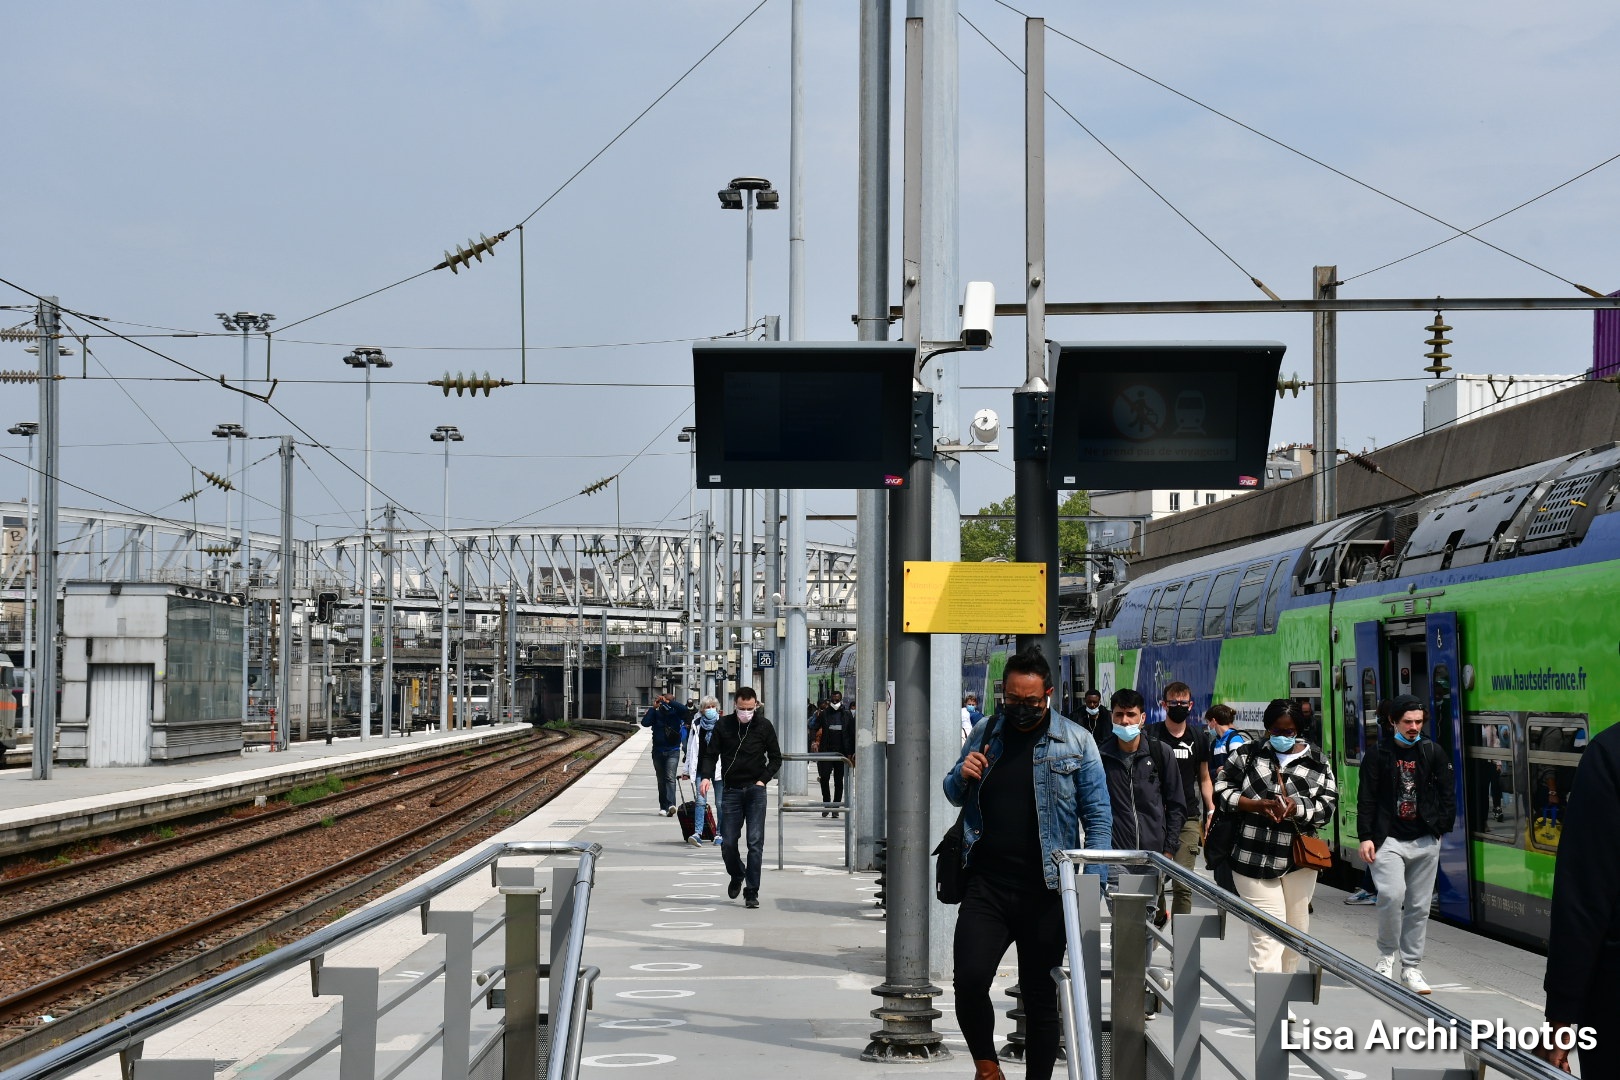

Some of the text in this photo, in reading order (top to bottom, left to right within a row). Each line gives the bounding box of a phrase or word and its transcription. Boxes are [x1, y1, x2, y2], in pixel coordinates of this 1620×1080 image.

[1103, 447, 1134, 458] prend
[1137, 448, 1156, 458] pas
[1160, 447, 1172, 456] de
[1175, 448, 1230, 458] voyageurs
[760, 657, 771, 665] 20
[1491, 666, 1587, 691] www.hautsdefrance.fr
